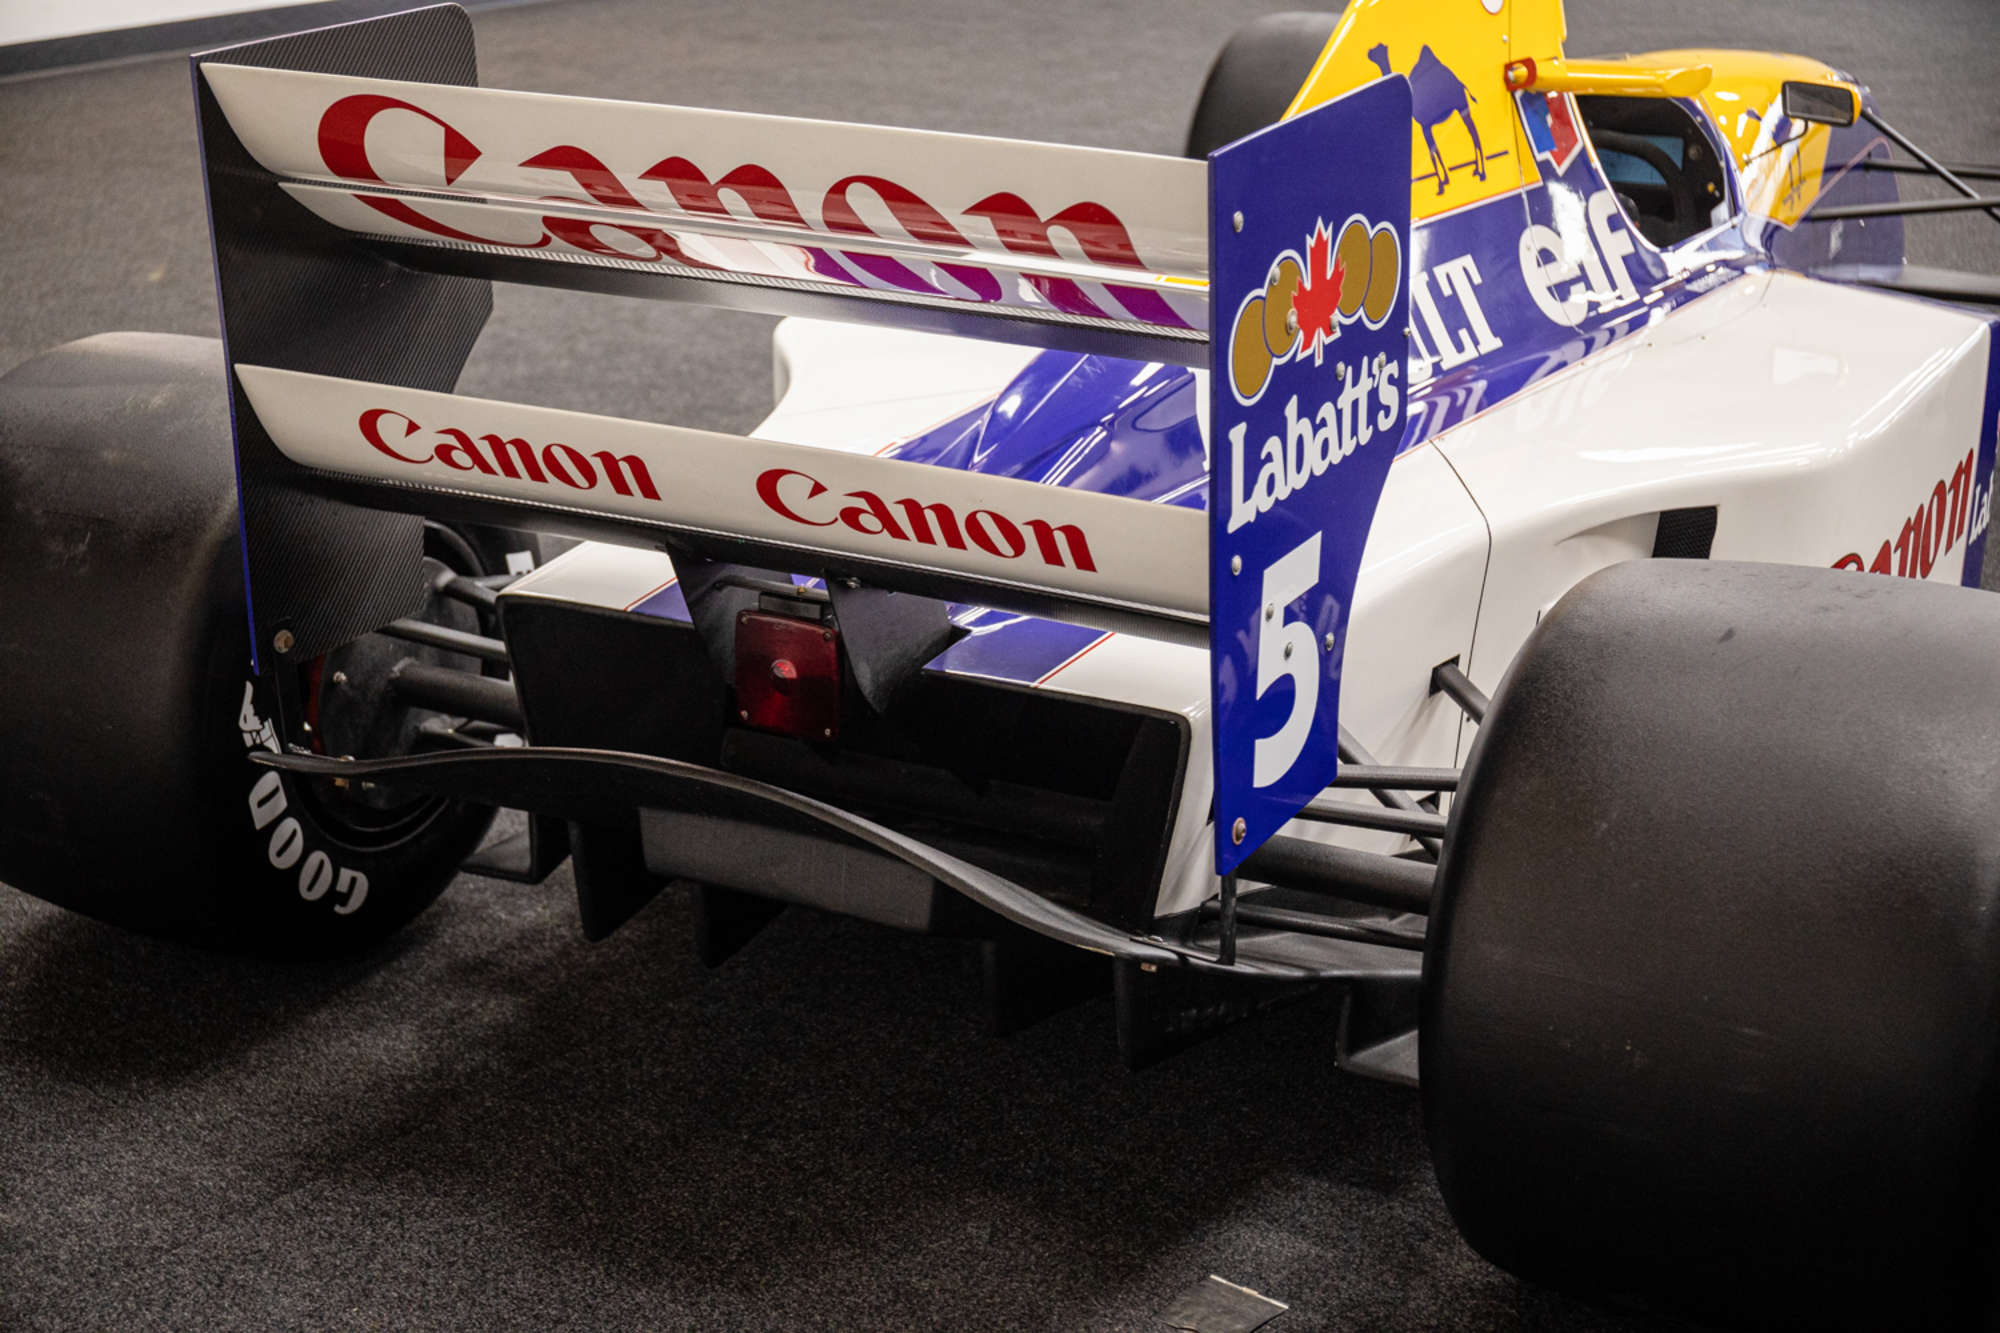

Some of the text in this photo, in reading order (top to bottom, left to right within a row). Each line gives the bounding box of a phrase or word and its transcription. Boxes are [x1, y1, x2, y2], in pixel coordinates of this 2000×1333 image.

[317, 94, 1193, 330] Canon
[1519, 189, 1640, 327] elf
[359, 408, 662, 501] Canon
[1226, 354, 1399, 534] Labatt's
[756, 468, 1098, 573] Canon
[1253, 530, 1322, 788] 5
[248, 770, 369, 915] GOOD
